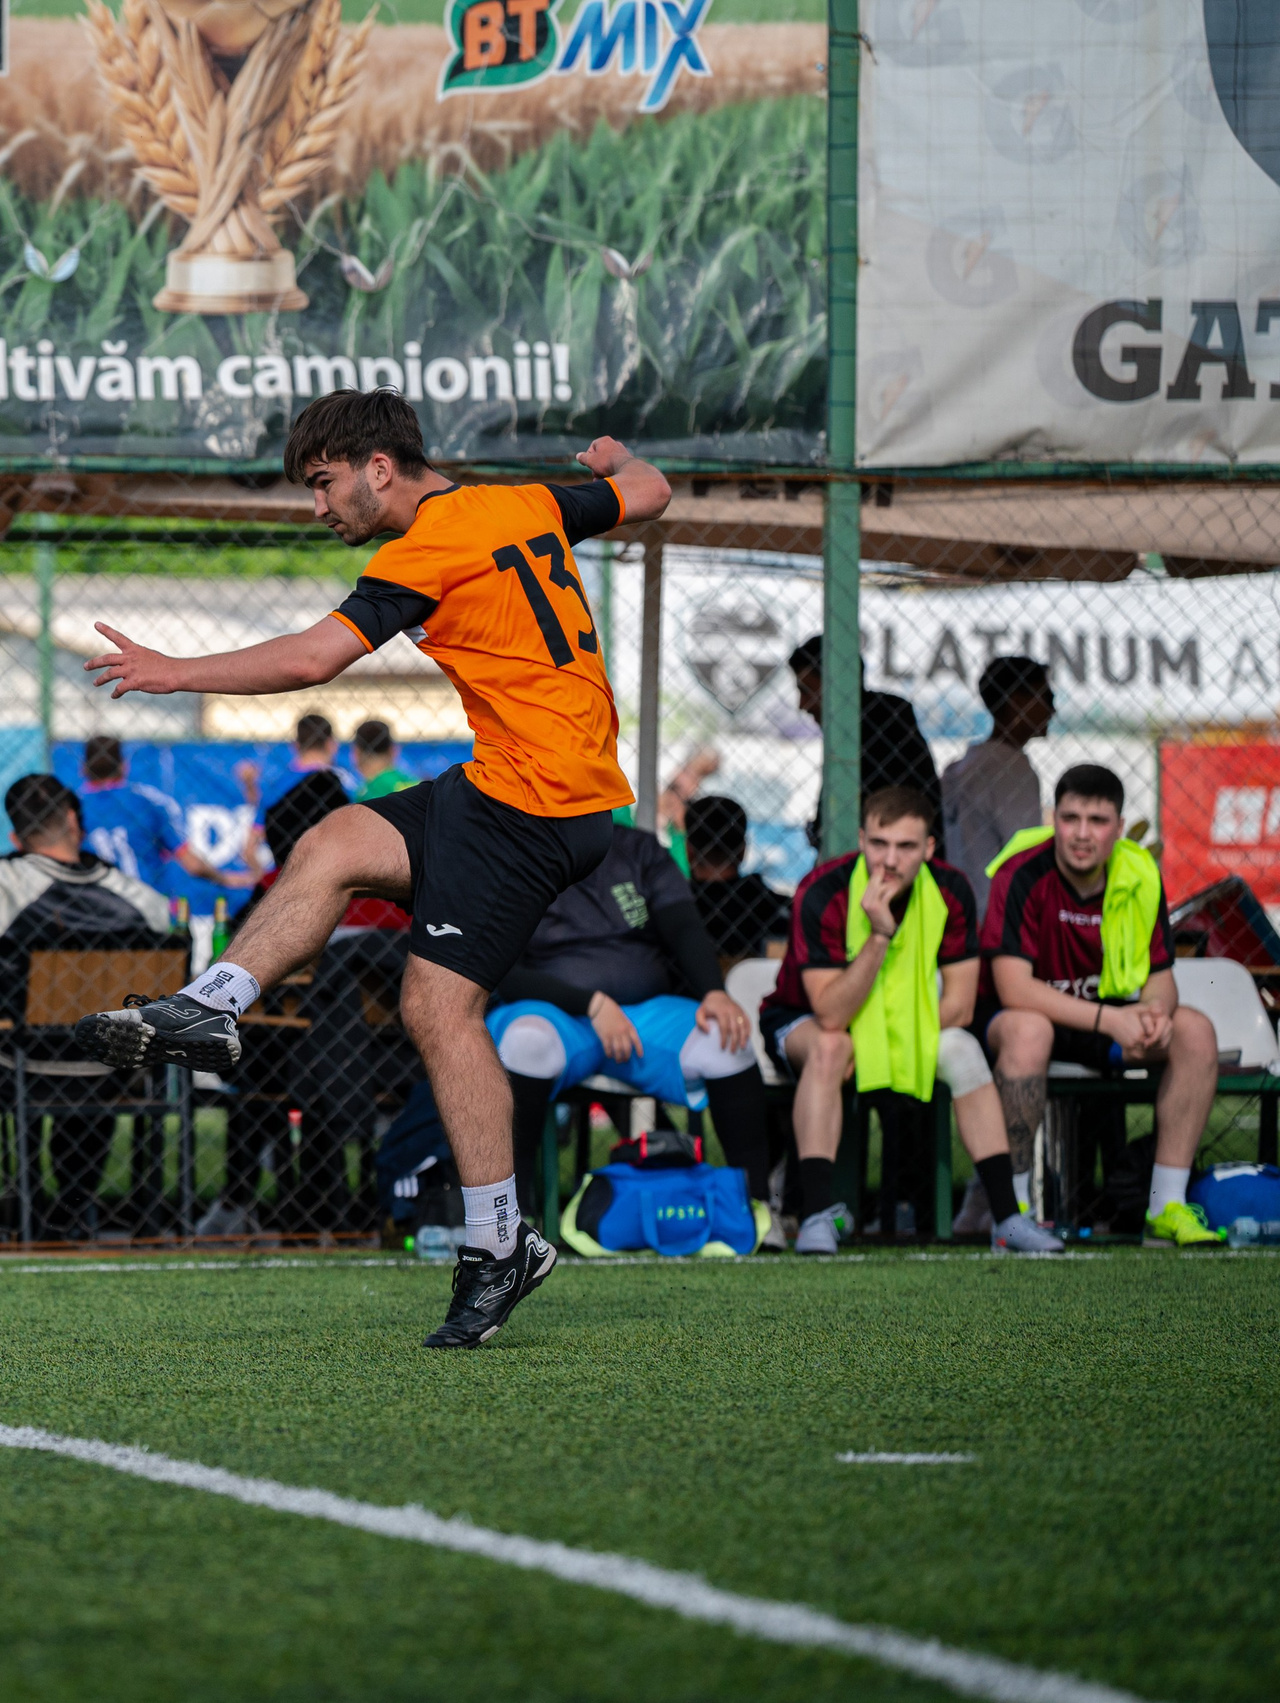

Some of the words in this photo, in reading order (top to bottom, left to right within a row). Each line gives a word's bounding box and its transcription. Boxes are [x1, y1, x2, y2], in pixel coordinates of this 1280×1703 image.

[463, 0, 551, 70] BT
[554, 0, 710, 111] MIX
[219, 341, 572, 403] campionii!
[491, 532, 598, 668] 13
[859, 627, 1200, 689] LATINUM
